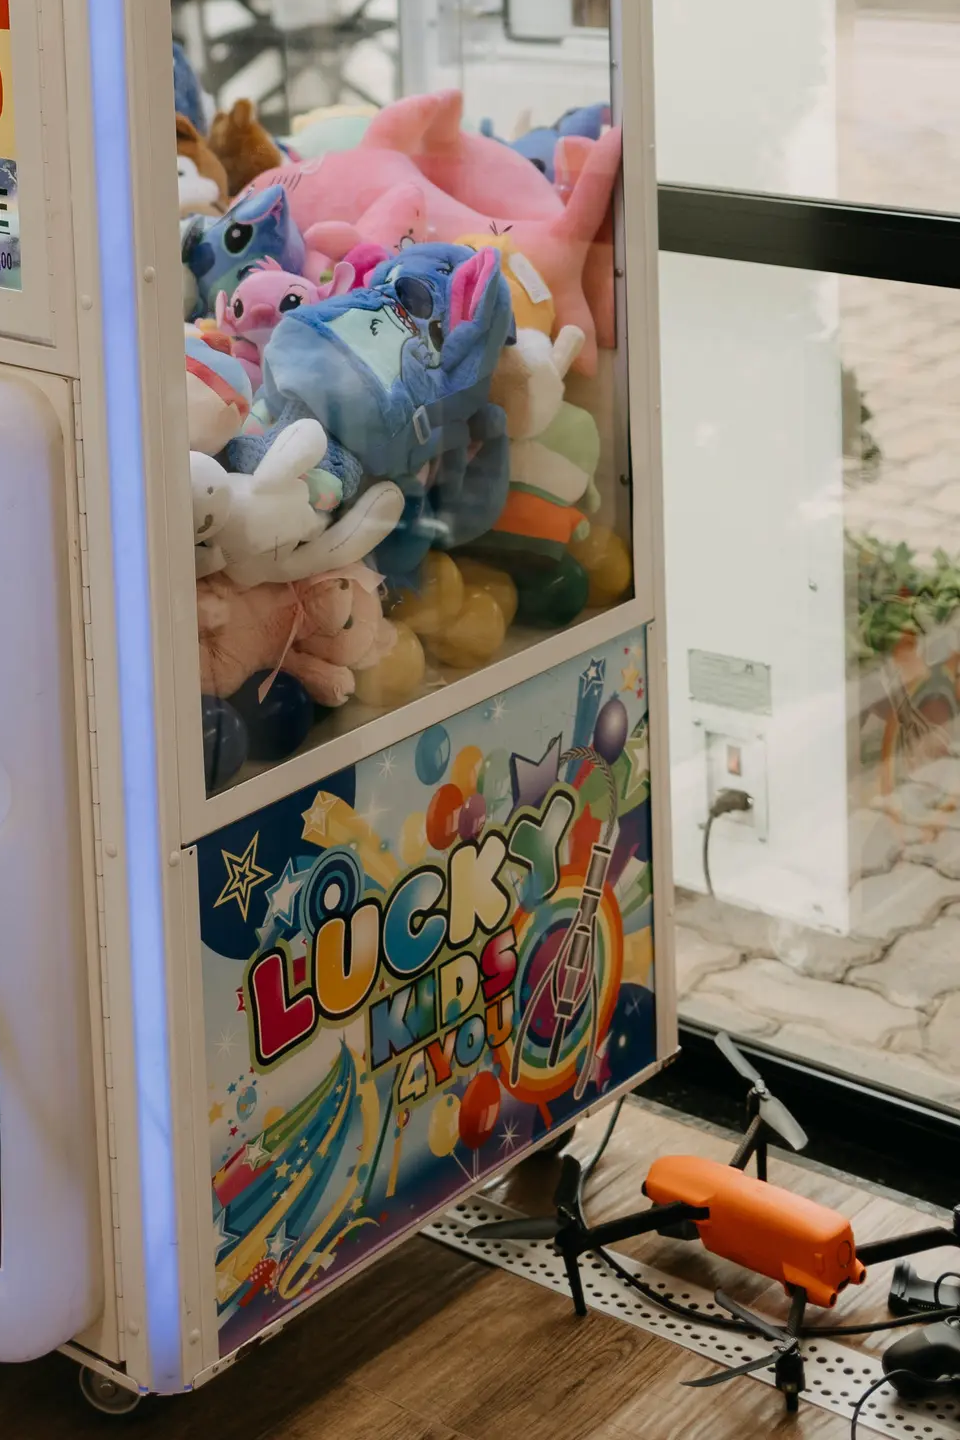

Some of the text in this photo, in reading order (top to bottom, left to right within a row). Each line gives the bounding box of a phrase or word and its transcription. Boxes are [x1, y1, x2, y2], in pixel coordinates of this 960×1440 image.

[248, 789, 576, 1067] LUCKY
[369, 925, 519, 1072] KIDS
[398, 993, 516, 1106] 4YOU
